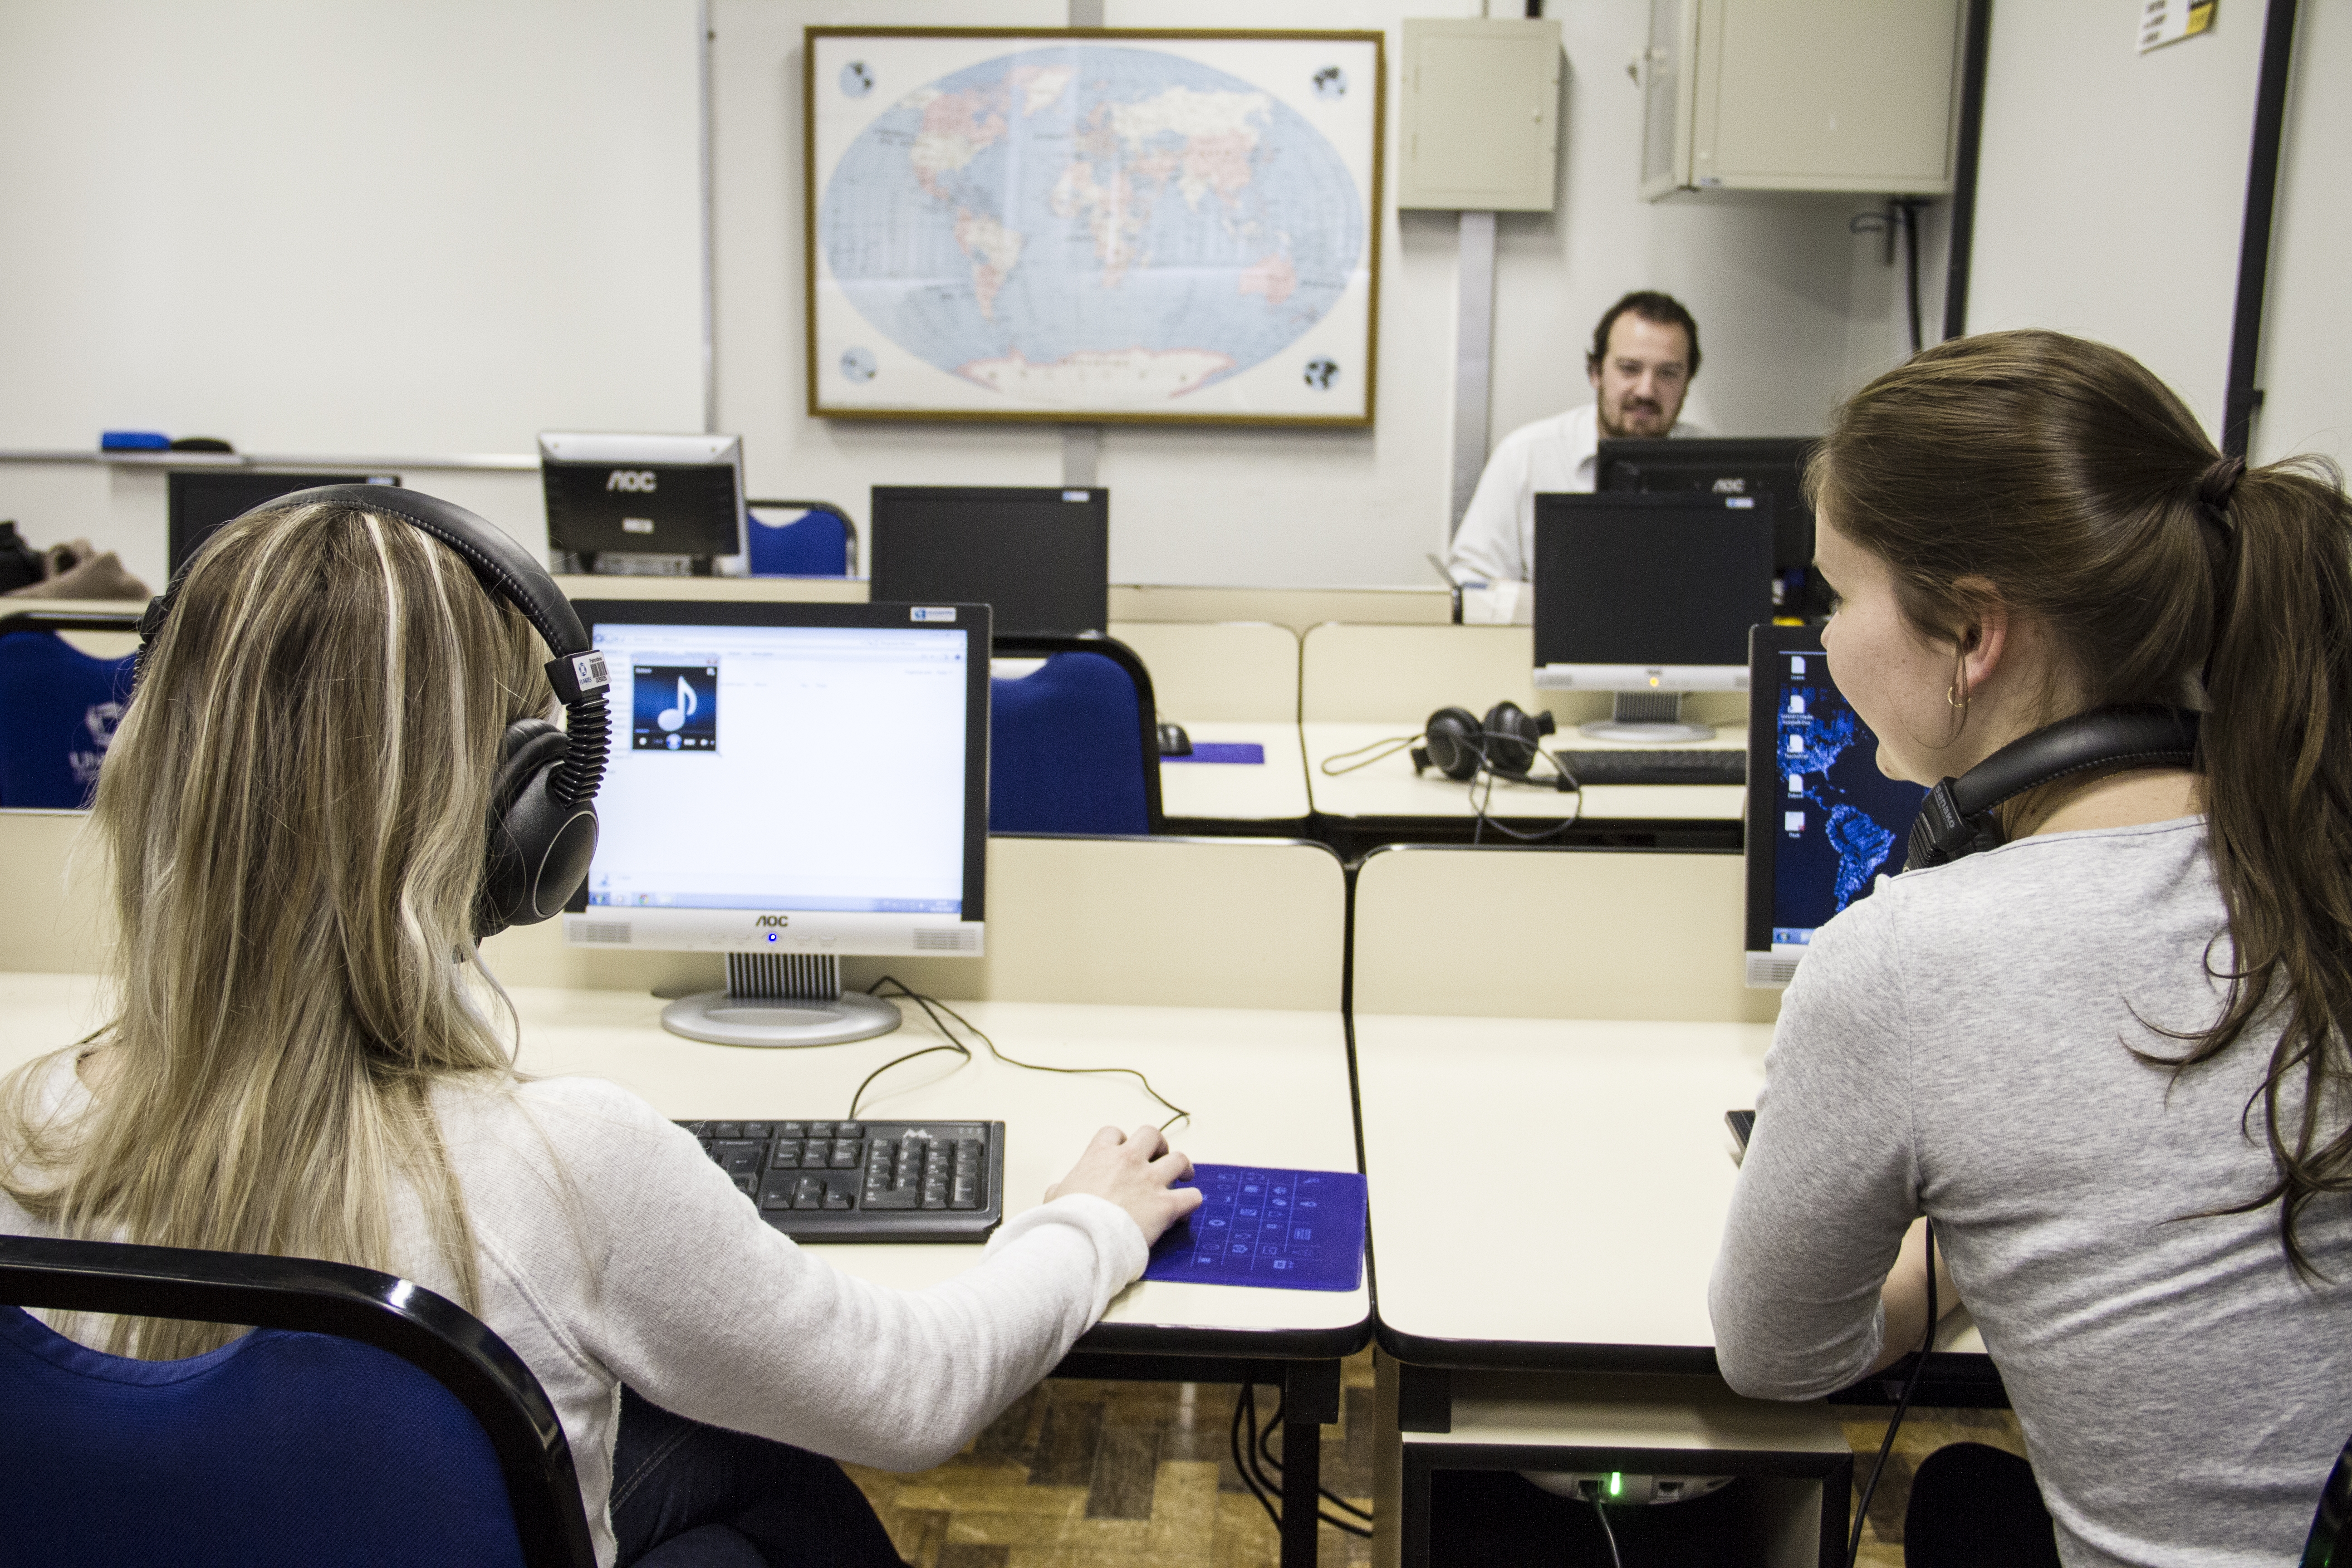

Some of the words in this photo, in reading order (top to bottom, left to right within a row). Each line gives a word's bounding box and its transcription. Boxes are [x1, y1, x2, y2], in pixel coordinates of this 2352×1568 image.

[607, 471, 656, 492] AOC
[1935, 785, 1955, 828] sanako
[755, 915, 788, 927] AOC
